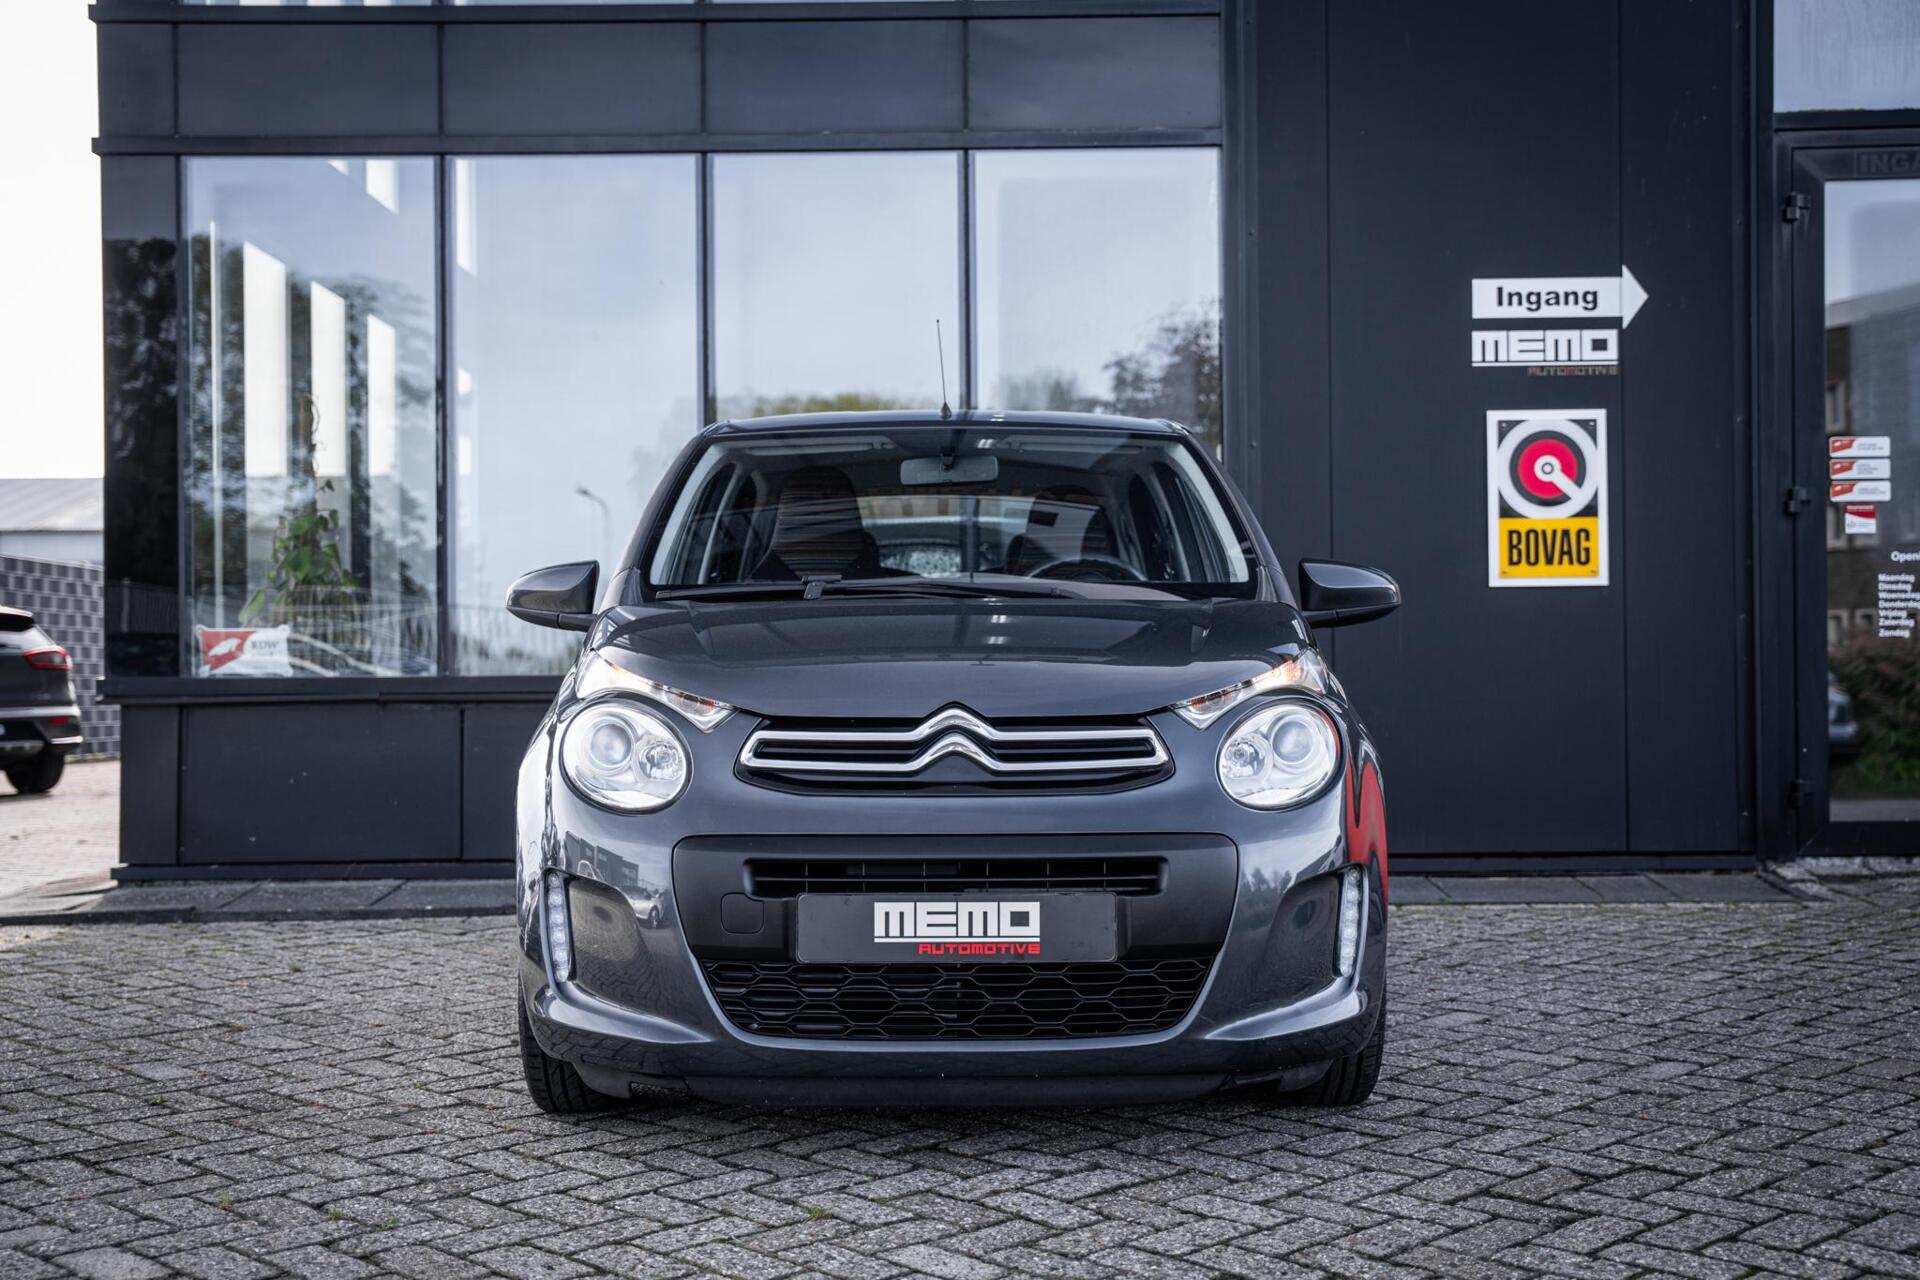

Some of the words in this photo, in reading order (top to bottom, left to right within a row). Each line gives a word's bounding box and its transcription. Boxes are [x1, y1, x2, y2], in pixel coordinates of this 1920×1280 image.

[1496, 286, 1598, 312] Ingang
[1472, 329, 1619, 362] MEMO
[1527, 366, 1619, 376] AUTOMOTIVE
[1507, 527, 1591, 567] BOVAG
[874, 901, 1041, 937] MEMO
[918, 943, 1041, 955] AUTOMOTIVE
